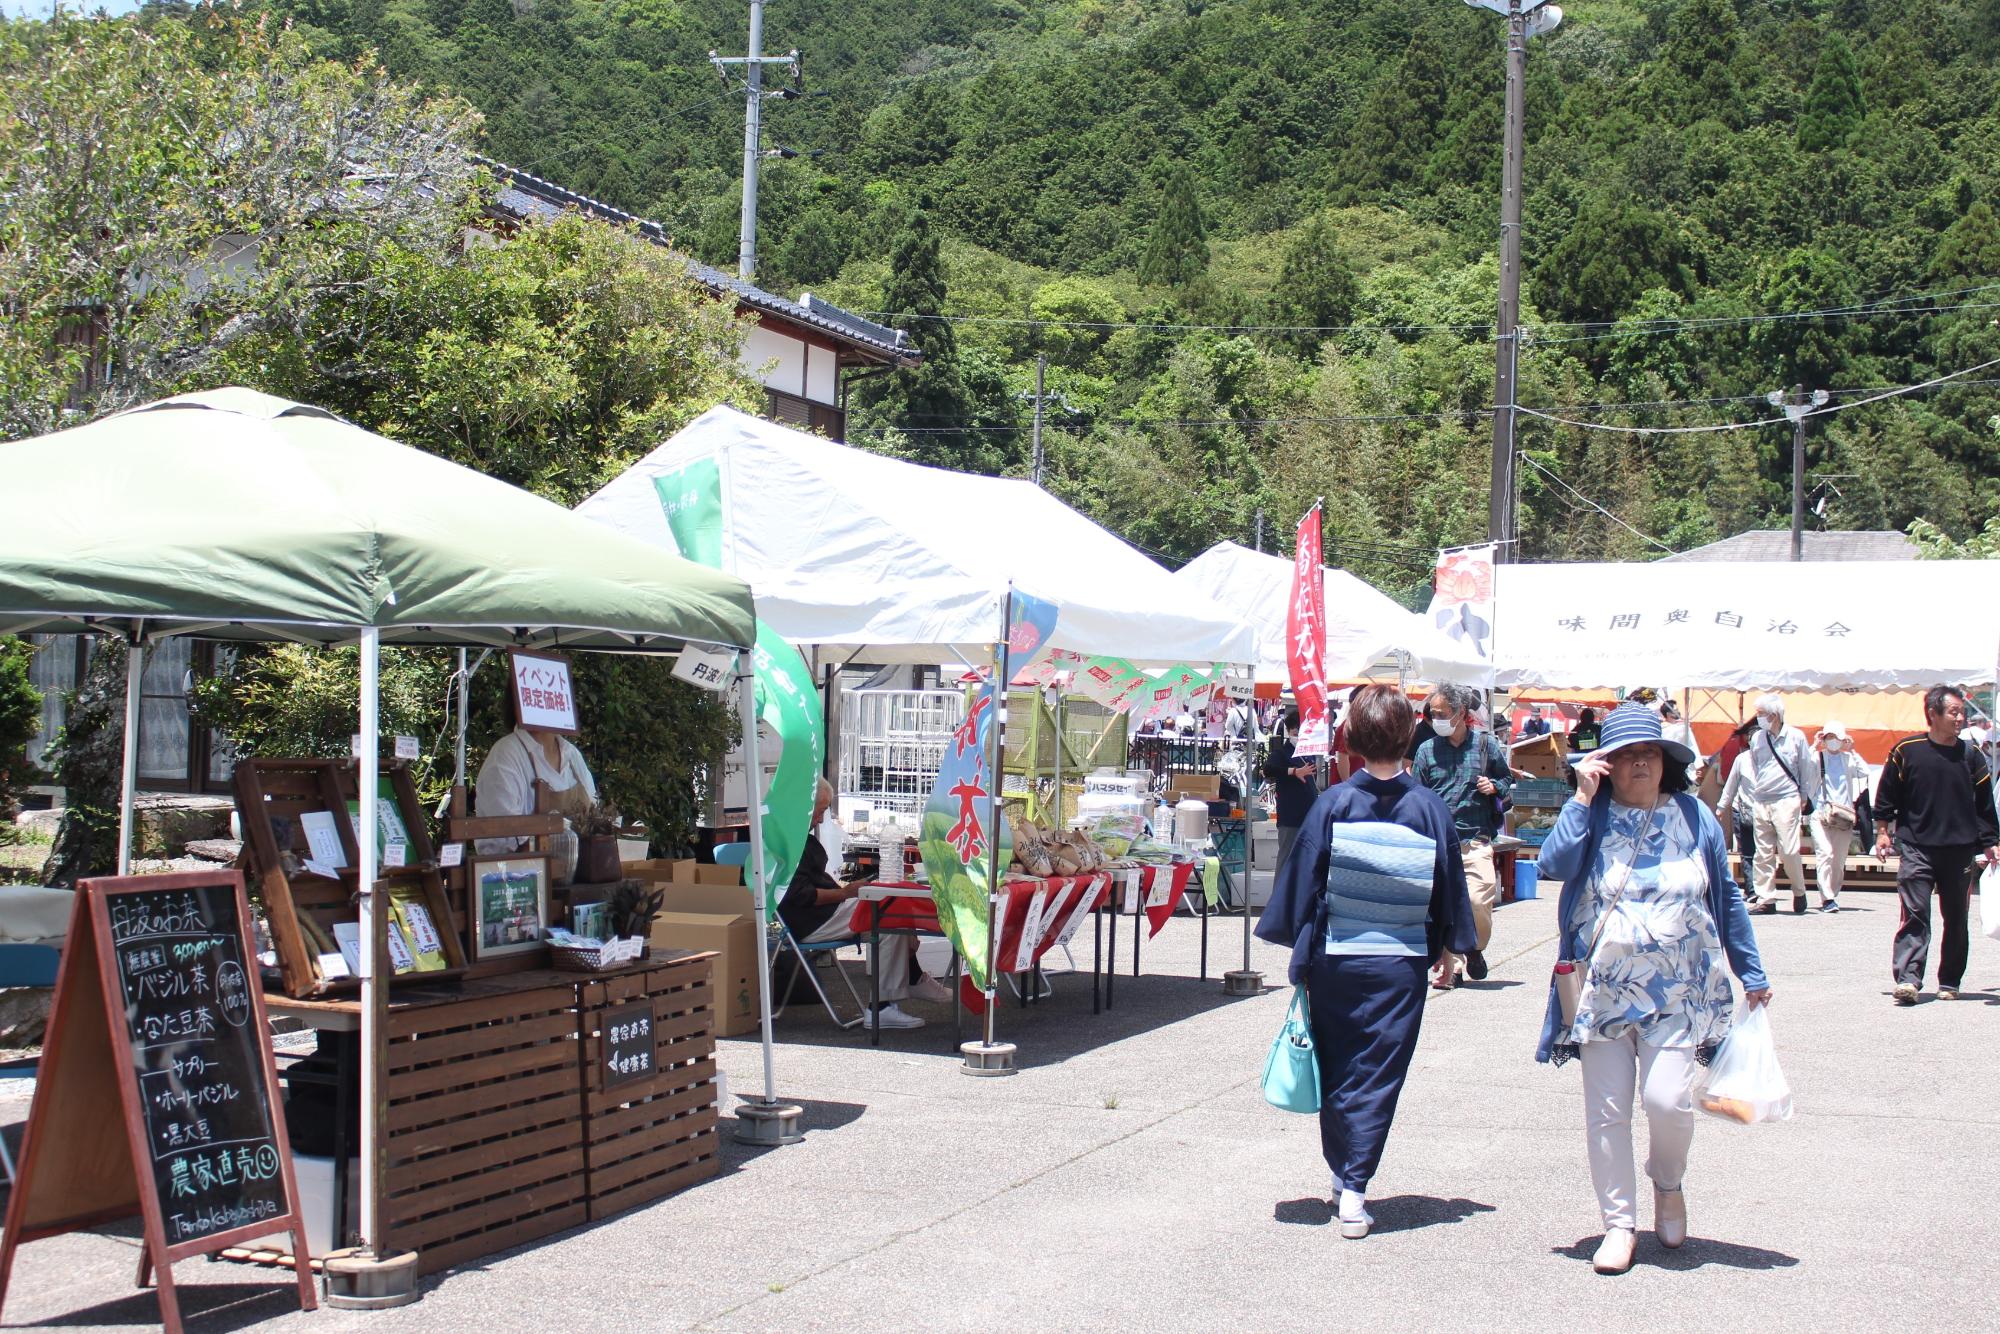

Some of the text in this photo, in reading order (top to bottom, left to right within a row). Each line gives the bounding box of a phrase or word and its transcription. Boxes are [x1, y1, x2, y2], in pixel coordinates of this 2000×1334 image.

[1557, 608, 1852, 638] 味間奥自治会
[519, 667, 566, 690] イベント
[521, 687, 571, 712] 限定価格!
[112, 898, 206, 937] 丹波のお茶
[138, 963, 210, 1000] バジル茶
[144, 1005, 215, 1040] なた豆茶
[610, 1018, 649, 1045] 農家直売
[619, 1052, 649, 1074] 健康茶
[161, 1082, 240, 1112] ホーリーバジル
[168, 1118, 212, 1147] 黒大豆
[170, 1146, 260, 1199] 農家直売
